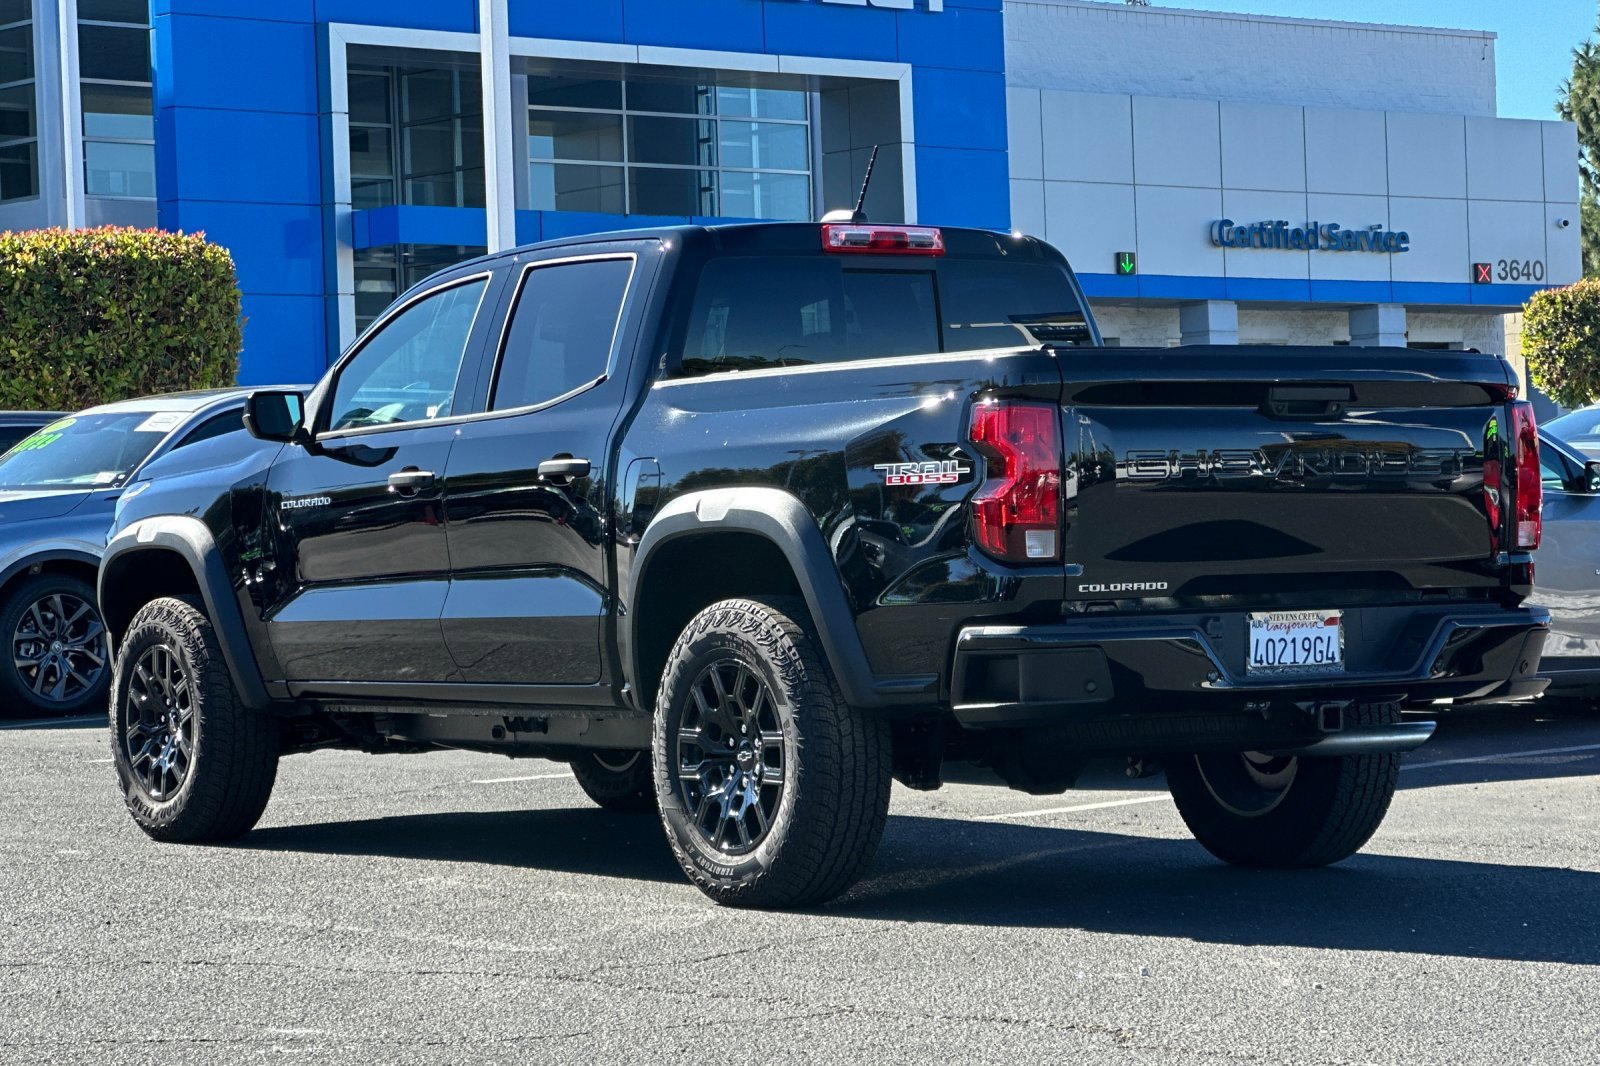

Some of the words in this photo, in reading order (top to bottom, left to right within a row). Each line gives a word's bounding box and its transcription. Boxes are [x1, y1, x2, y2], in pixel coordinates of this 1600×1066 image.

[1211, 219, 1319, 250] Certified
[1320, 222, 1410, 253] Service
[1497, 259, 1545, 281] 3640
[874, 460, 970, 475] TRAIL
[1126, 448, 1475, 478] CHEVROLET
[886, 473, 959, 485] BOSS
[281, 497, 331, 510] COLORADO
[1078, 582, 1168, 593] COLORADO
[1269, 613, 1298, 621] STEVENS
[1299, 612, 1321, 621] CREEK
[1253, 635, 1337, 665] 40219G4
[695, 855, 735, 877] TERRITORY
